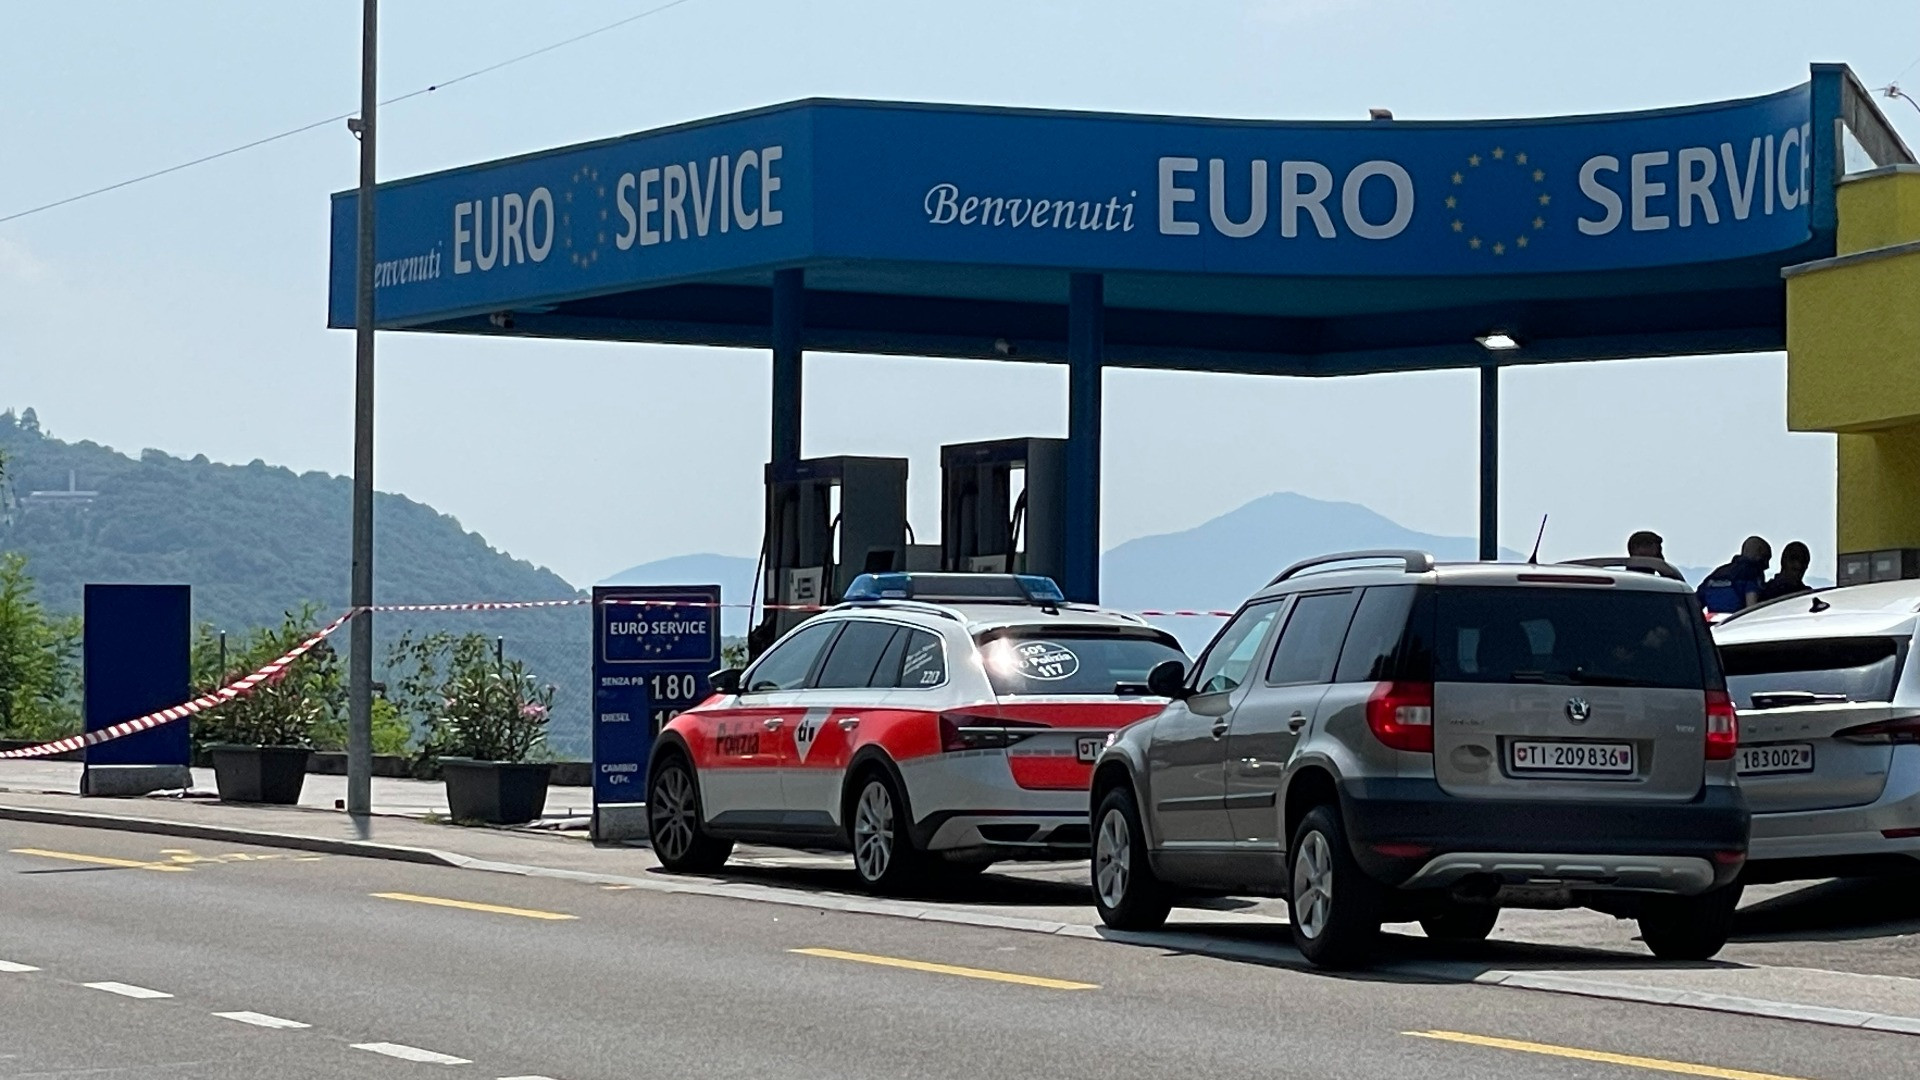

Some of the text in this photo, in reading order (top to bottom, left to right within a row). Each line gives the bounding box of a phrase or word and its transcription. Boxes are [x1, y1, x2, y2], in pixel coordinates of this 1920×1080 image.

[924, 122, 1811, 239] Benvenuti EURO SERVICE
[374, 145, 783, 288] envenuti EURO SERVICE
[610, 621, 706, 635] EURO SERVICE
[1020, 645, 1046, 656] SOS
[1029, 653, 1073, 666] Polizia
[1038, 663, 1063, 677] 117
[601, 677, 630, 686] SENZA
[631, 677, 644, 686] PB
[601, 713, 631, 722] DIESEL
[1743, 749, 1799, 769] 183002
[601, 763, 638, 773] CAMBIO
